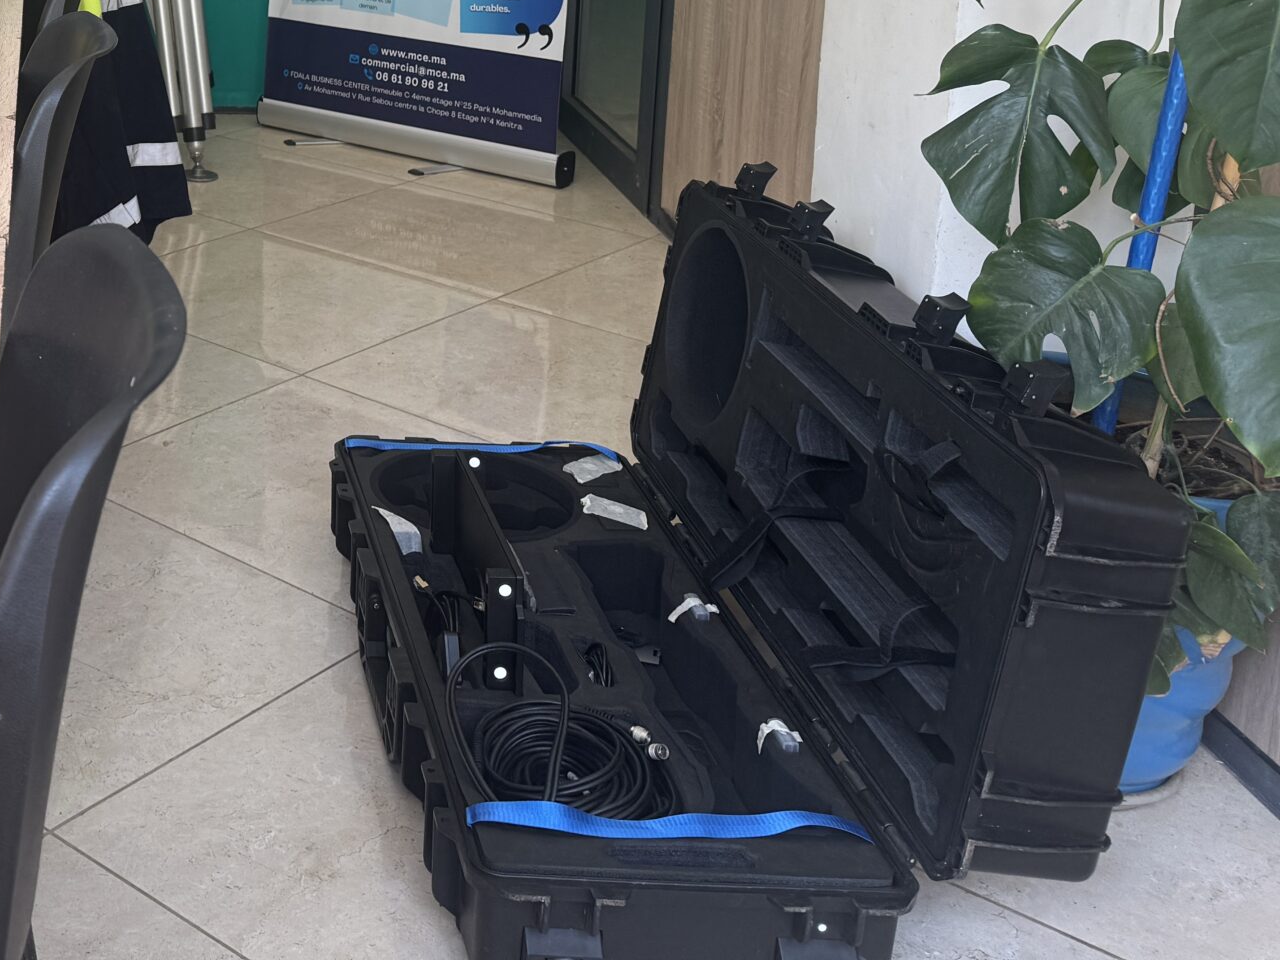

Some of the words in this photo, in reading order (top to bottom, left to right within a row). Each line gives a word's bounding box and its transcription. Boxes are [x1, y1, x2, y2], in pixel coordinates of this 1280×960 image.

[469, 4, 511, 13] durables.
[380, 47, 447, 65] www.mce.ma
[361, 57, 466, 82] commercial@mce.ma
[375, 71, 389, 82] 06
[391, 73, 403, 84] 61
[404, 75, 419, 87] 90
[421, 78, 435, 90] 96
[437, 81, 449, 92] 21
[311, 74, 342, 87] BUSINESS
[343, 78, 370, 92] CENTER
[473, 103, 491, 113] Park
[492, 107, 543, 123] Mohammedia
[313, 84, 351, 99] Mohammed
[357, 93, 371, 102] Rue
[394, 100, 417, 111] centre
